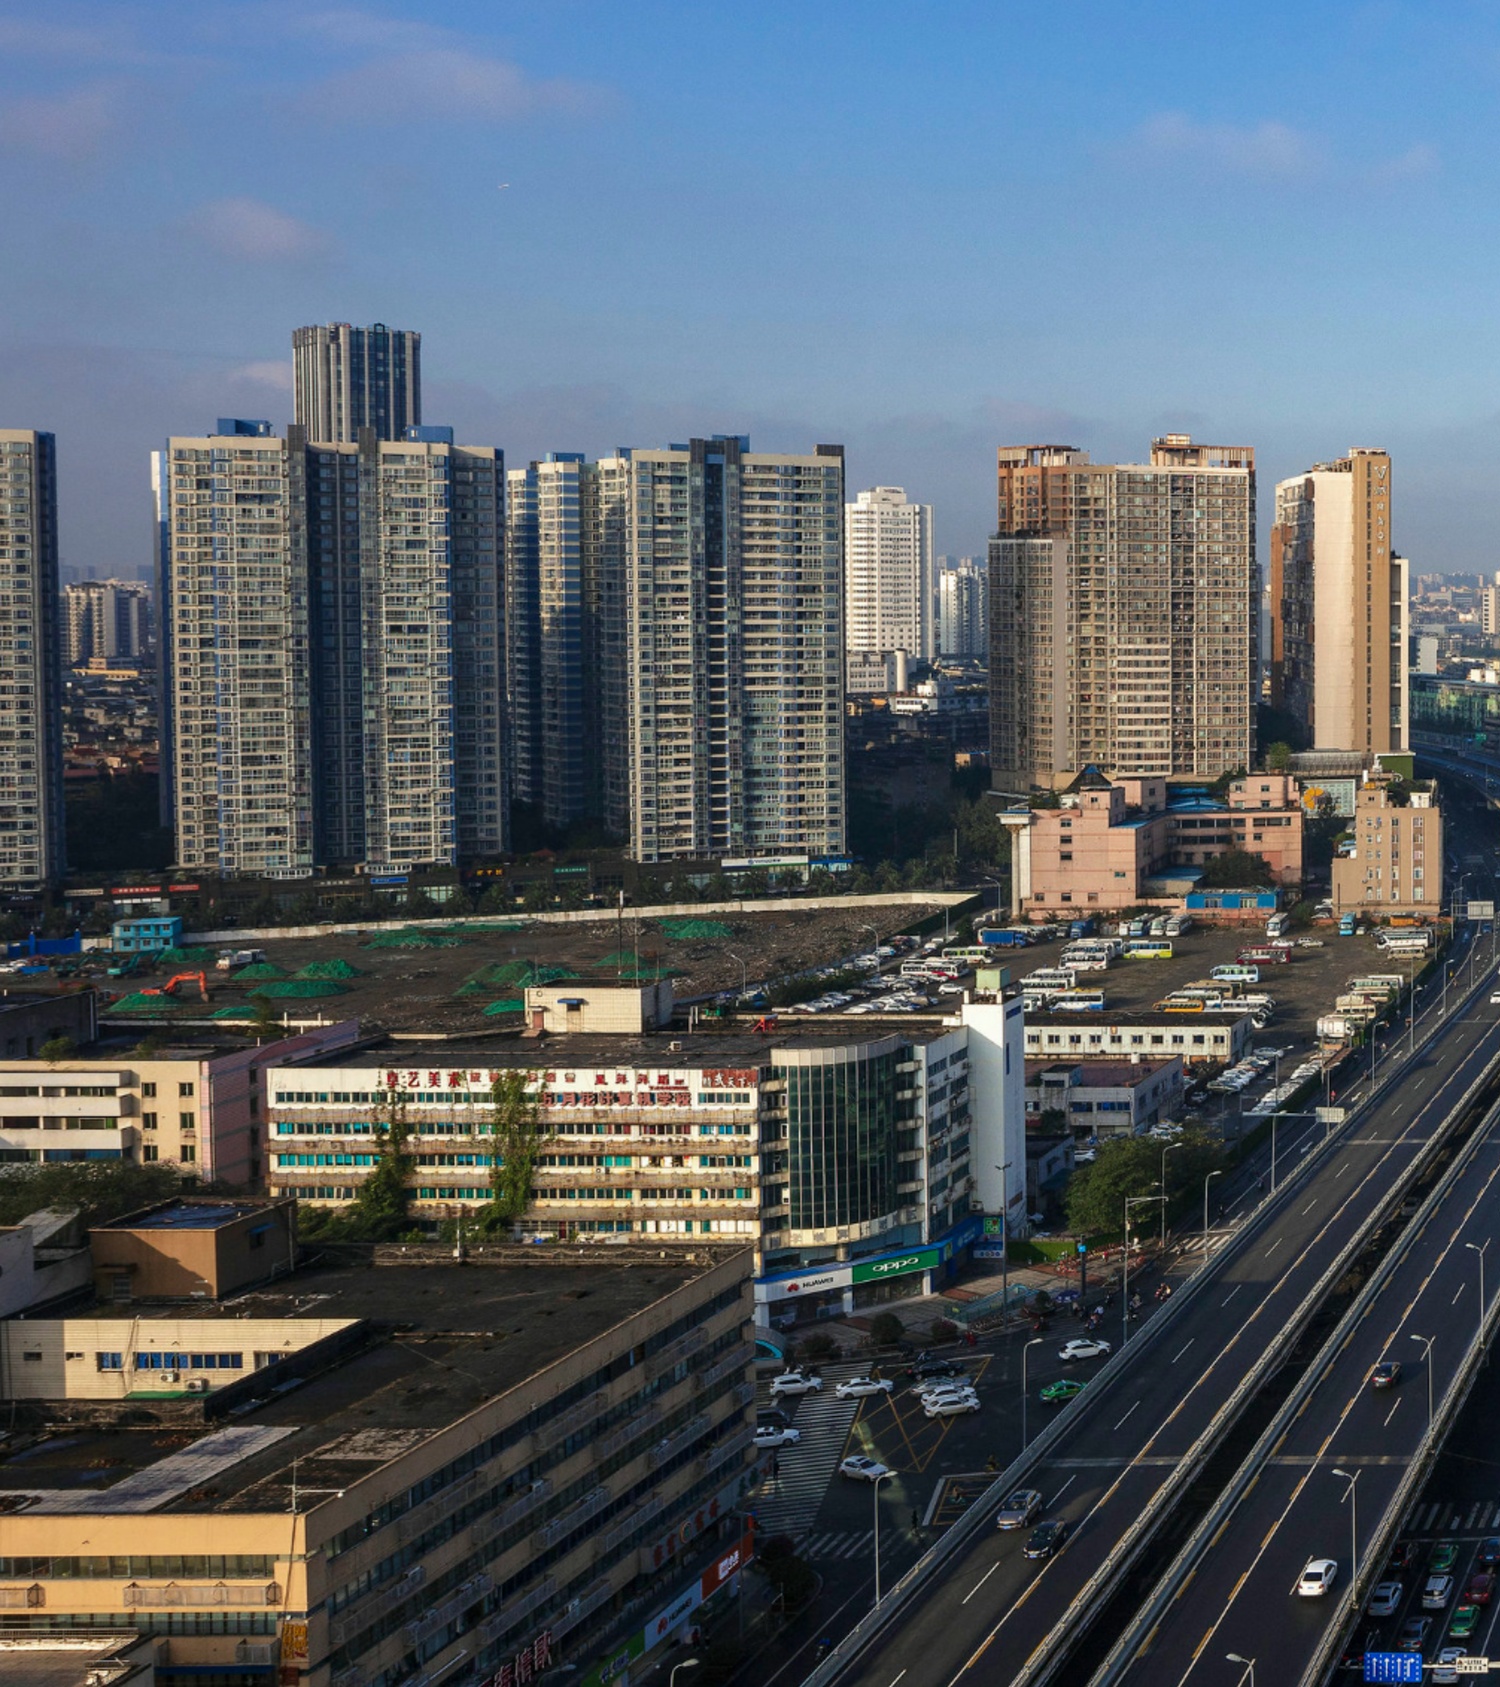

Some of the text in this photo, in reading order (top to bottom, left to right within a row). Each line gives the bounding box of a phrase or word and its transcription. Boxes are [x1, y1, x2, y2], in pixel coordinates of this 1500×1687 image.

[541, 1091, 692, 1107] 五月花计算机学校
[802, 1277, 834, 1288] HUAWEI
